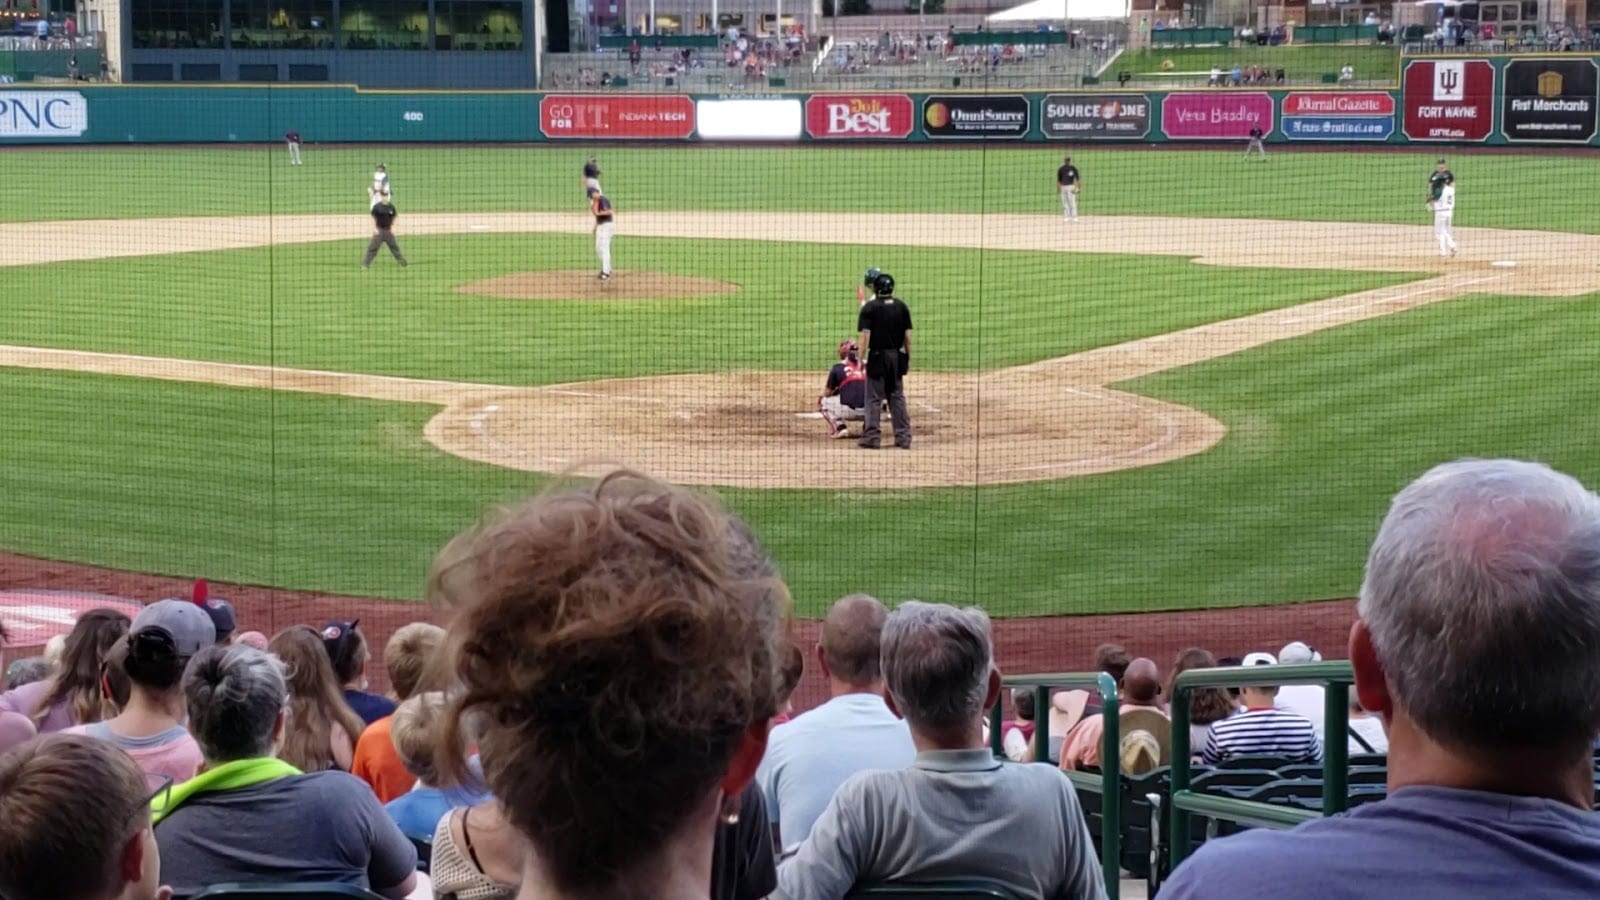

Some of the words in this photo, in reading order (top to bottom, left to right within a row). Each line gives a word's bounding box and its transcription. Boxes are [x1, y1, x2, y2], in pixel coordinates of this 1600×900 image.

[1047, 103, 1101, 118] SOURCE
[1296, 97, 1336, 111] Journal
[1338, 97, 1380, 111] Gazette
[1512, 99, 1532, 111] First
[1533, 99, 1589, 111] Merchants
[403, 111, 424, 121] 400
[550, 104, 573, 119] GO
[827, 103, 892, 133] Best
[951, 109, 1025, 121] OmniSource
[1176, 107, 1206, 123] Vera
[1211, 105, 1260, 124] Bradley
[1418, 106, 1443, 118] FORT
[1445, 106, 1477, 118] WAYNE
[551, 119, 572, 129] FOR
